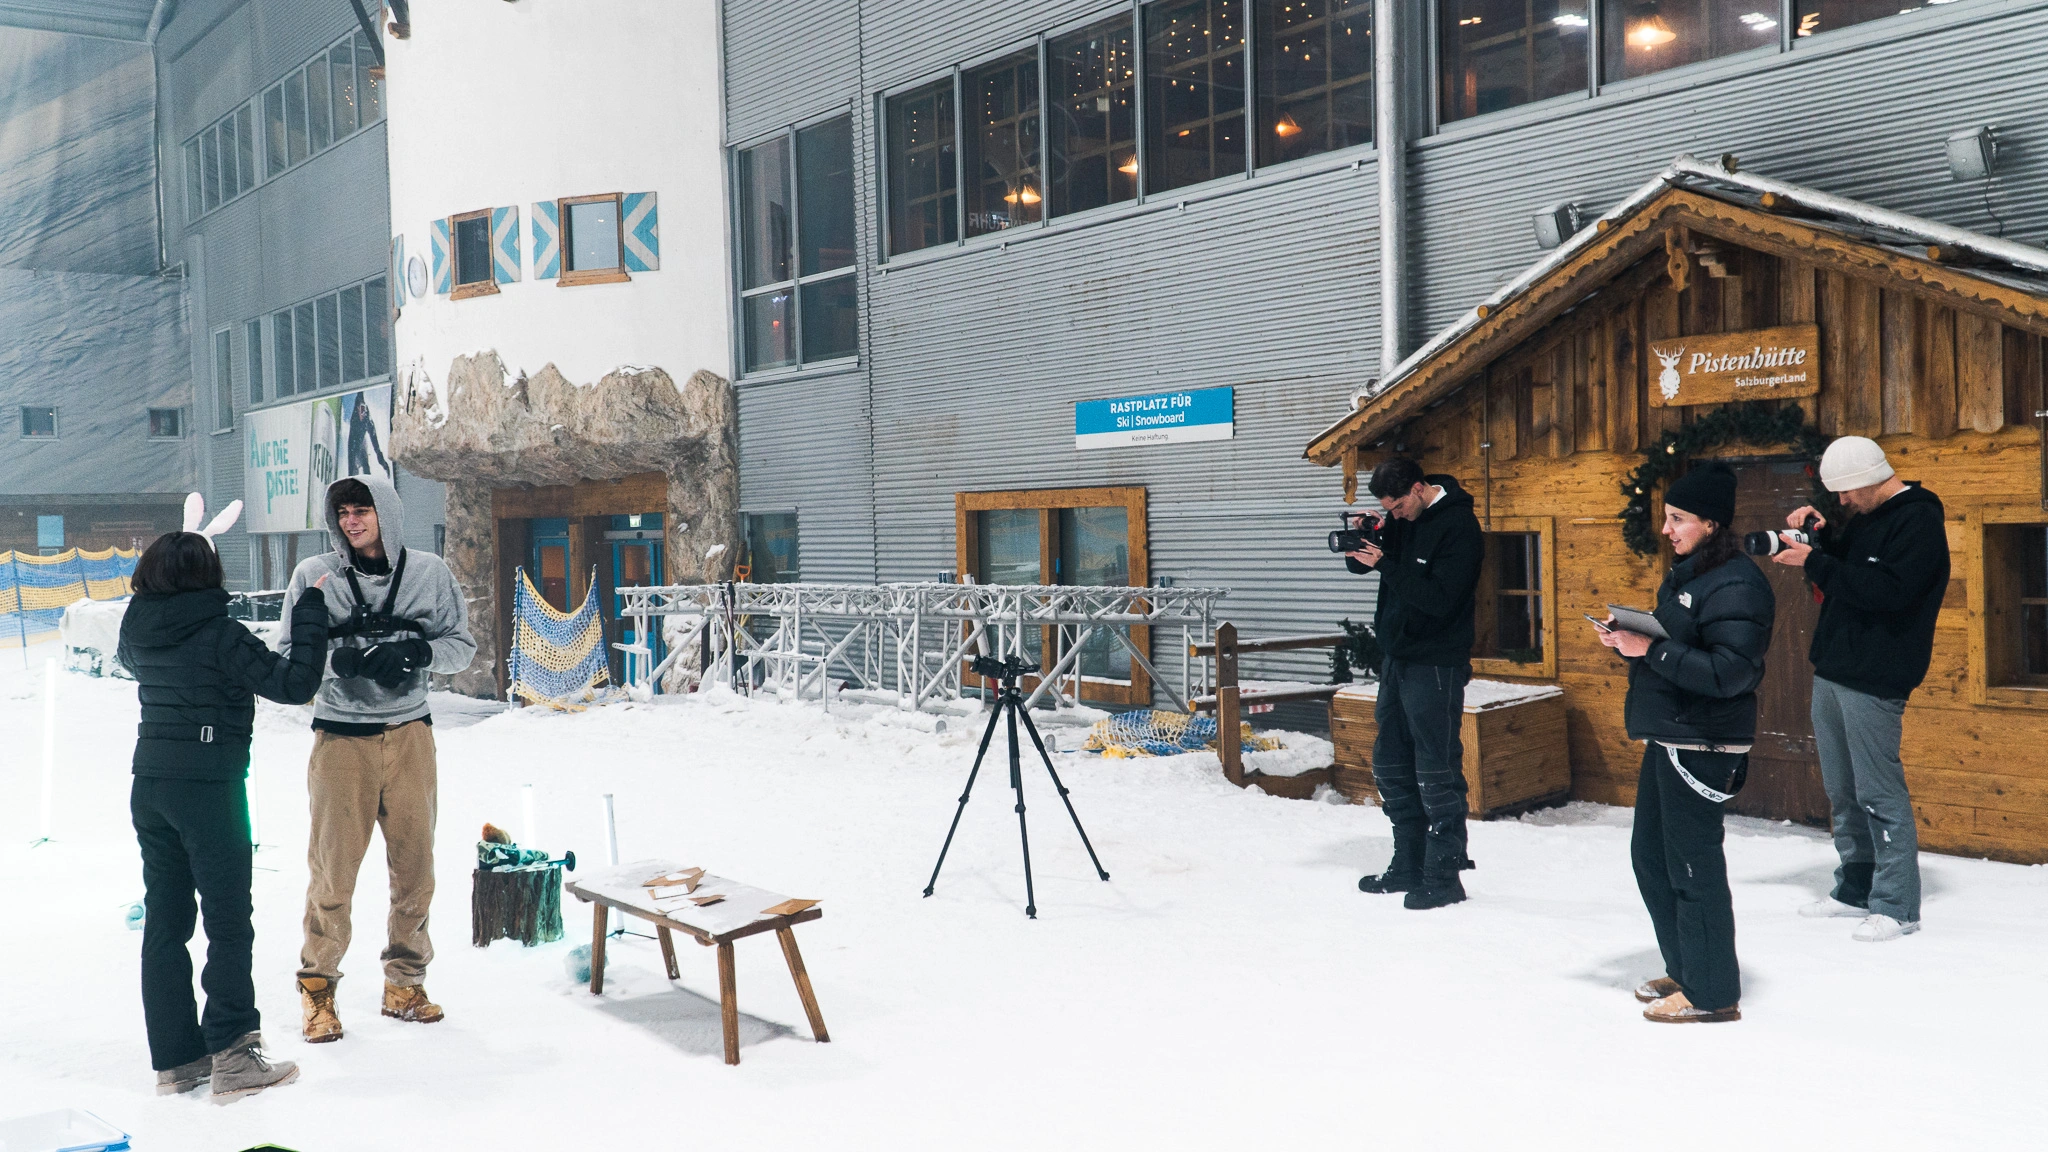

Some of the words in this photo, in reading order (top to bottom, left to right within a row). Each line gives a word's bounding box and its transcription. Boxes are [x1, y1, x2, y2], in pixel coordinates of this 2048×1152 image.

[1688, 346, 1807, 375] Pistenhütte
[1735, 371, 1807, 387] SalzburgerLand
[1110, 397, 1168, 414] RASTPLATZ
[1170, 393, 1192, 408] FÜR
[1116, 415, 1130, 427] Ski
[1135, 411, 1185, 426] Snowboard
[1131, 434, 1147, 442] Keine
[1147, 433, 1169, 442] Haftung
[249, 428, 271, 468] AUF
